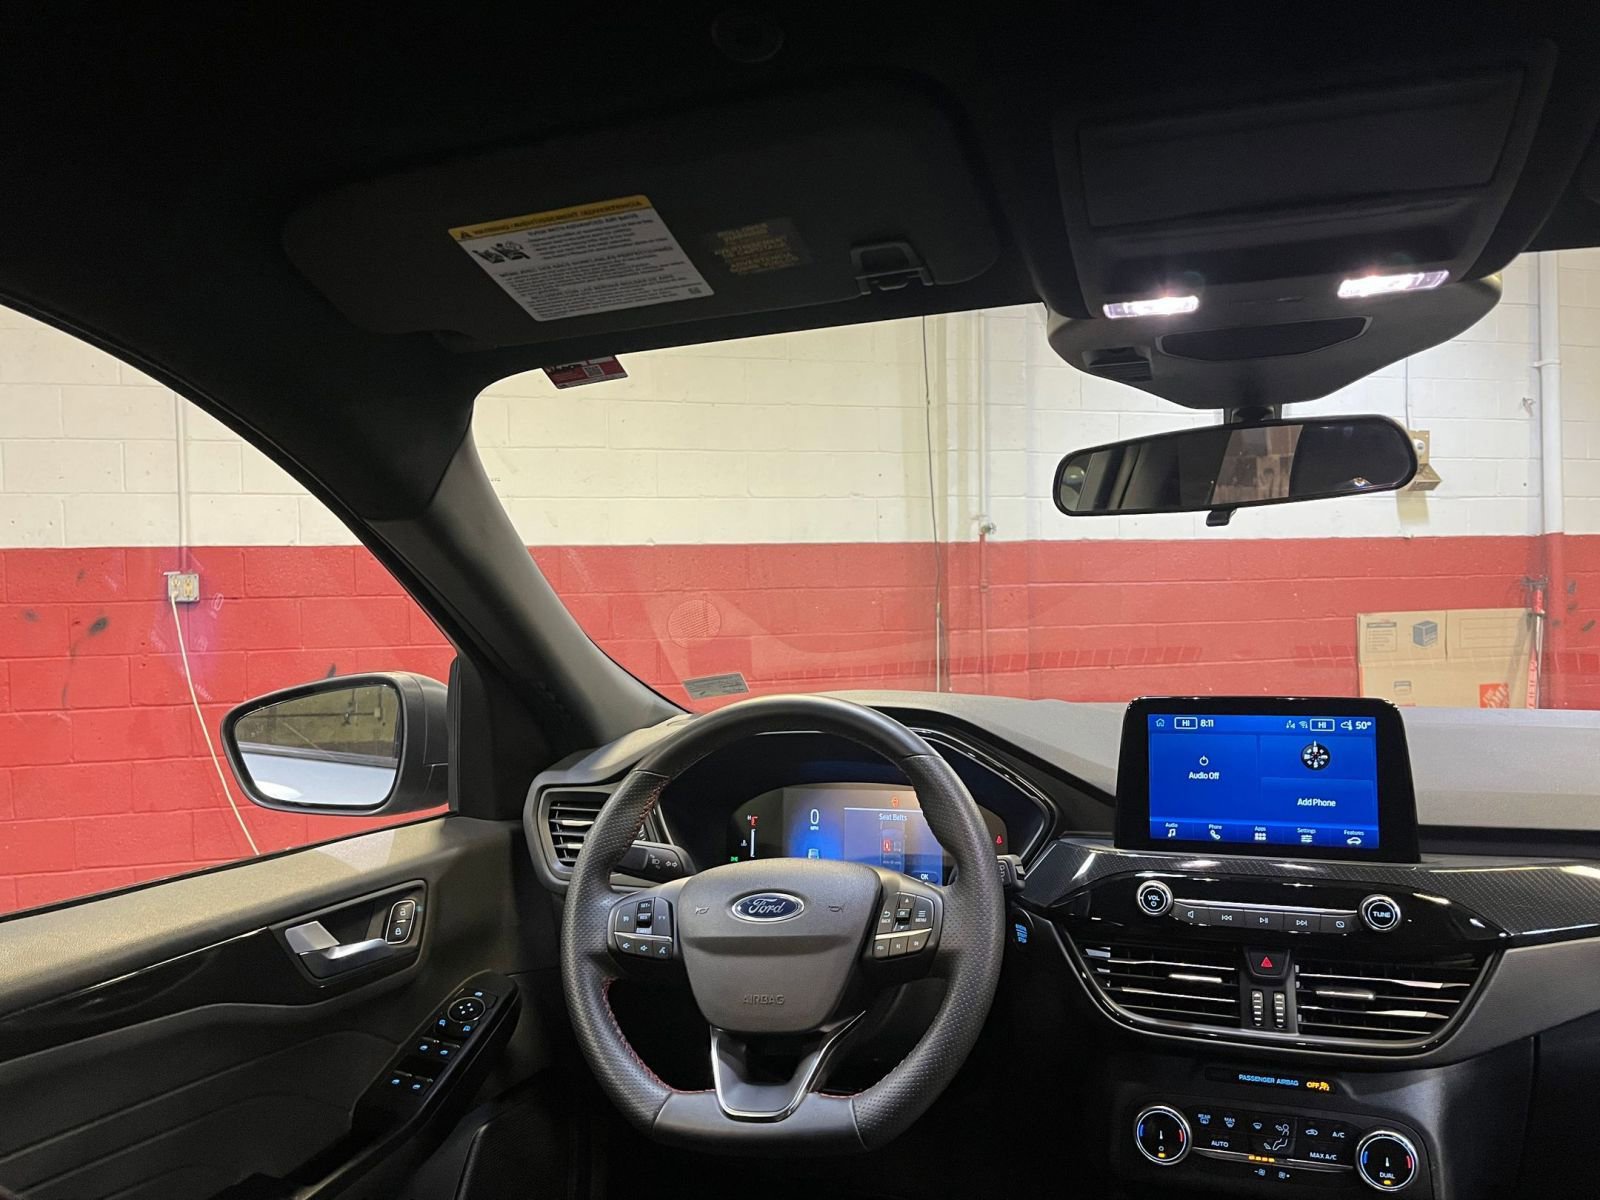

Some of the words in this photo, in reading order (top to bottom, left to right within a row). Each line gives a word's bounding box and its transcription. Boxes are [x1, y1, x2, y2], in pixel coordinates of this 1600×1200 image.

[1182, 719, 1190, 727] HI
[1200, 719, 1214, 728] 8:11
[1318, 721, 1327, 729] HI
[1355, 720, 1372, 730] 50°
[1188, 771, 1209, 780] Audio
[1209, 771, 1220, 780] Off
[1297, 798, 1312, 807] Add
[1313, 798, 1336, 807] Phone
[810, 808, 820, 825] 0
[879, 813, 893, 821] Seat
[1297, 827, 1316, 836] Settings
[1147, 894, 1160, 902] VOL
[748, 898, 786, 914] Ford
[1372, 910, 1390, 918] TUNE
[743, 994, 785, 1005] AIRBAG
[1239, 1073, 1274, 1084] PASSENGER
[1276, 1078, 1299, 1087] AIRBAG
[1306, 1081, 1320, 1089] OFF
[1332, 1131, 1345, 1139] A/C
[1211, 1140, 1229, 1148] AUTO
[1310, 1152, 1324, 1160] MAX
[1324, 1153, 1338, 1161] A/C
[1379, 1172, 1396, 1180] DUAL
